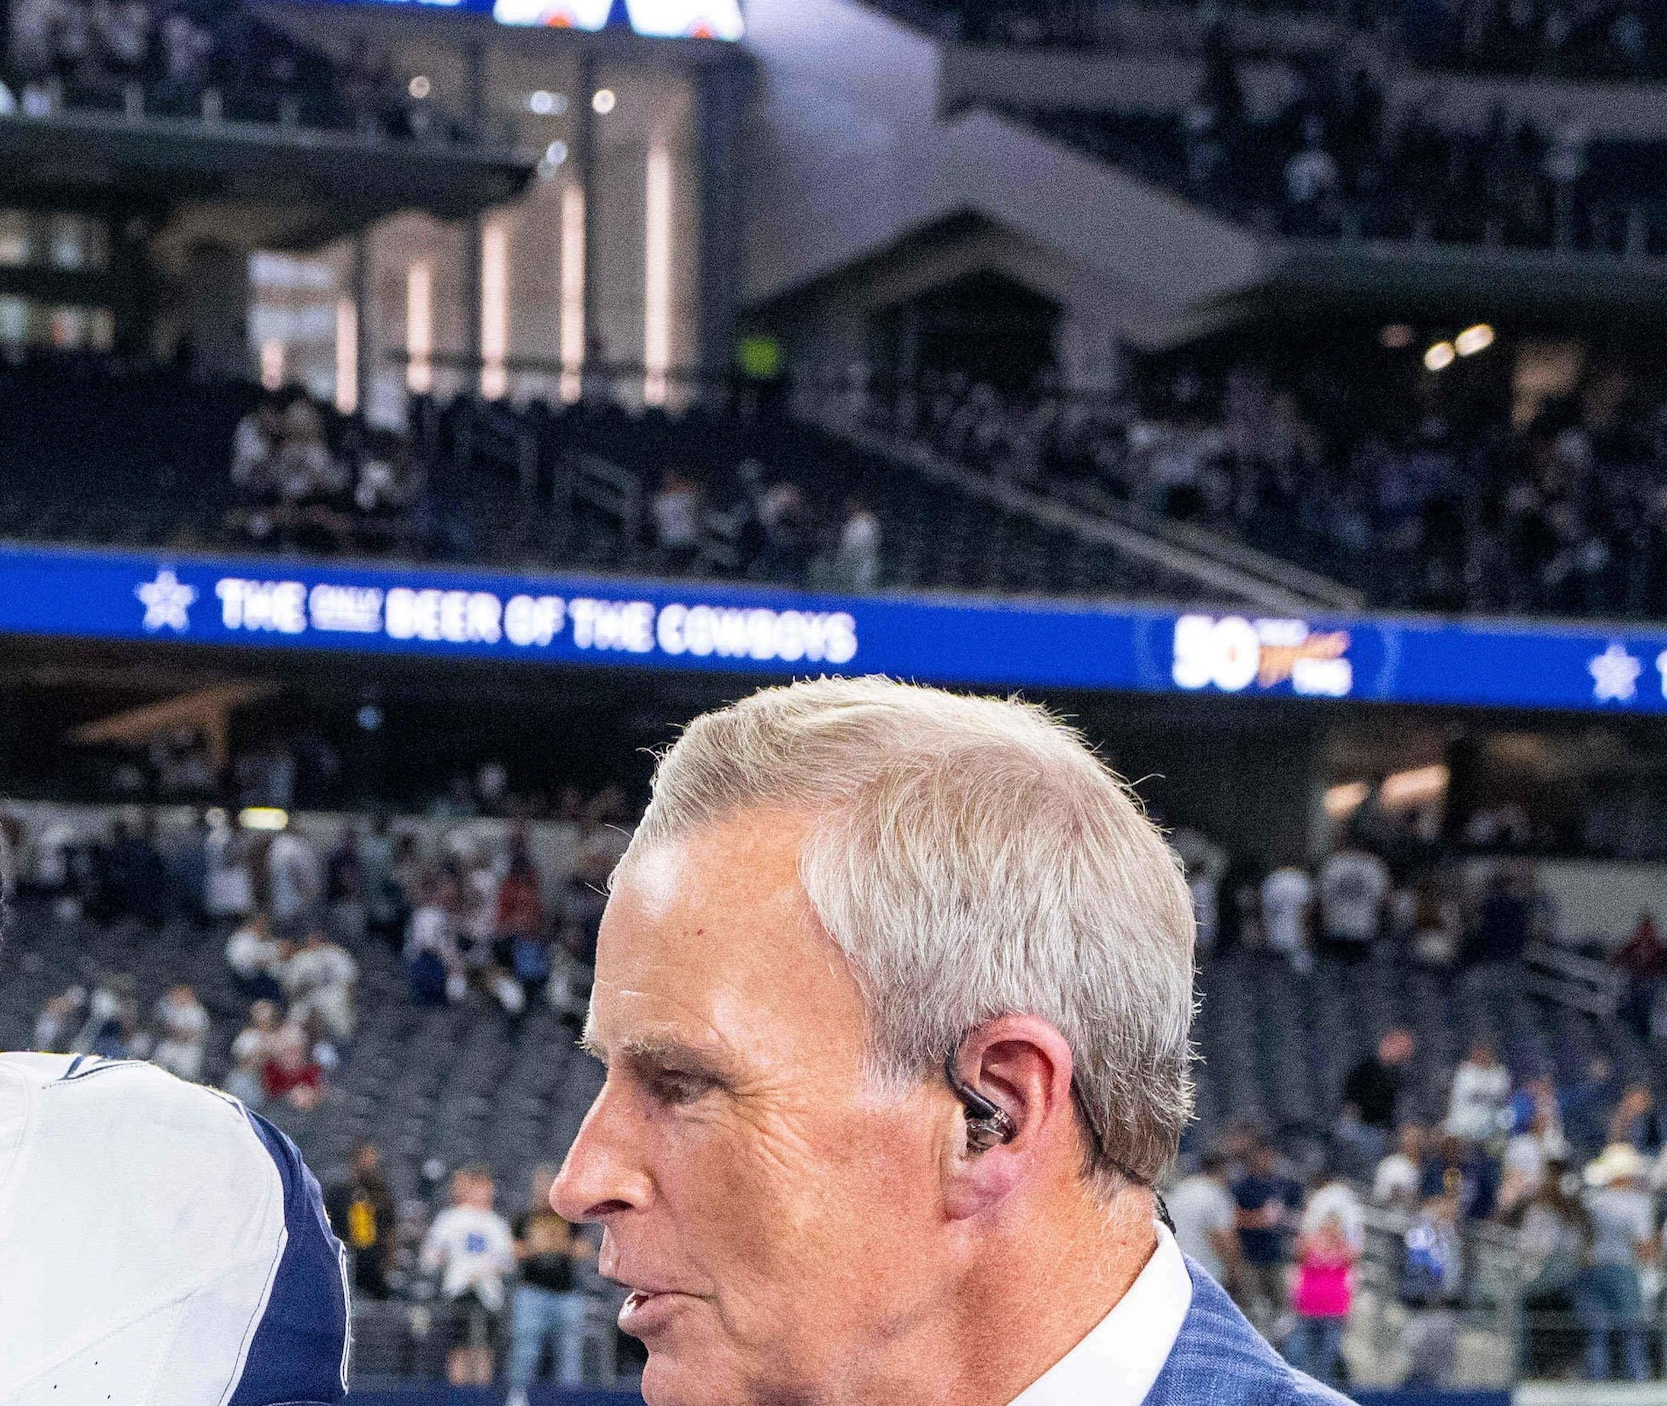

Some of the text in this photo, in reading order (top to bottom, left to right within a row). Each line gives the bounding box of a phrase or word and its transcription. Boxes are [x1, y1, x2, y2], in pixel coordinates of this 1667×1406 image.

[215, 577, 307, 634] THE
[385, 587, 502, 644] BEER
[504, 594, 565, 647] OF
[569, 598, 655, 653] THE
[657, 603, 859, 664] COWBOYS
